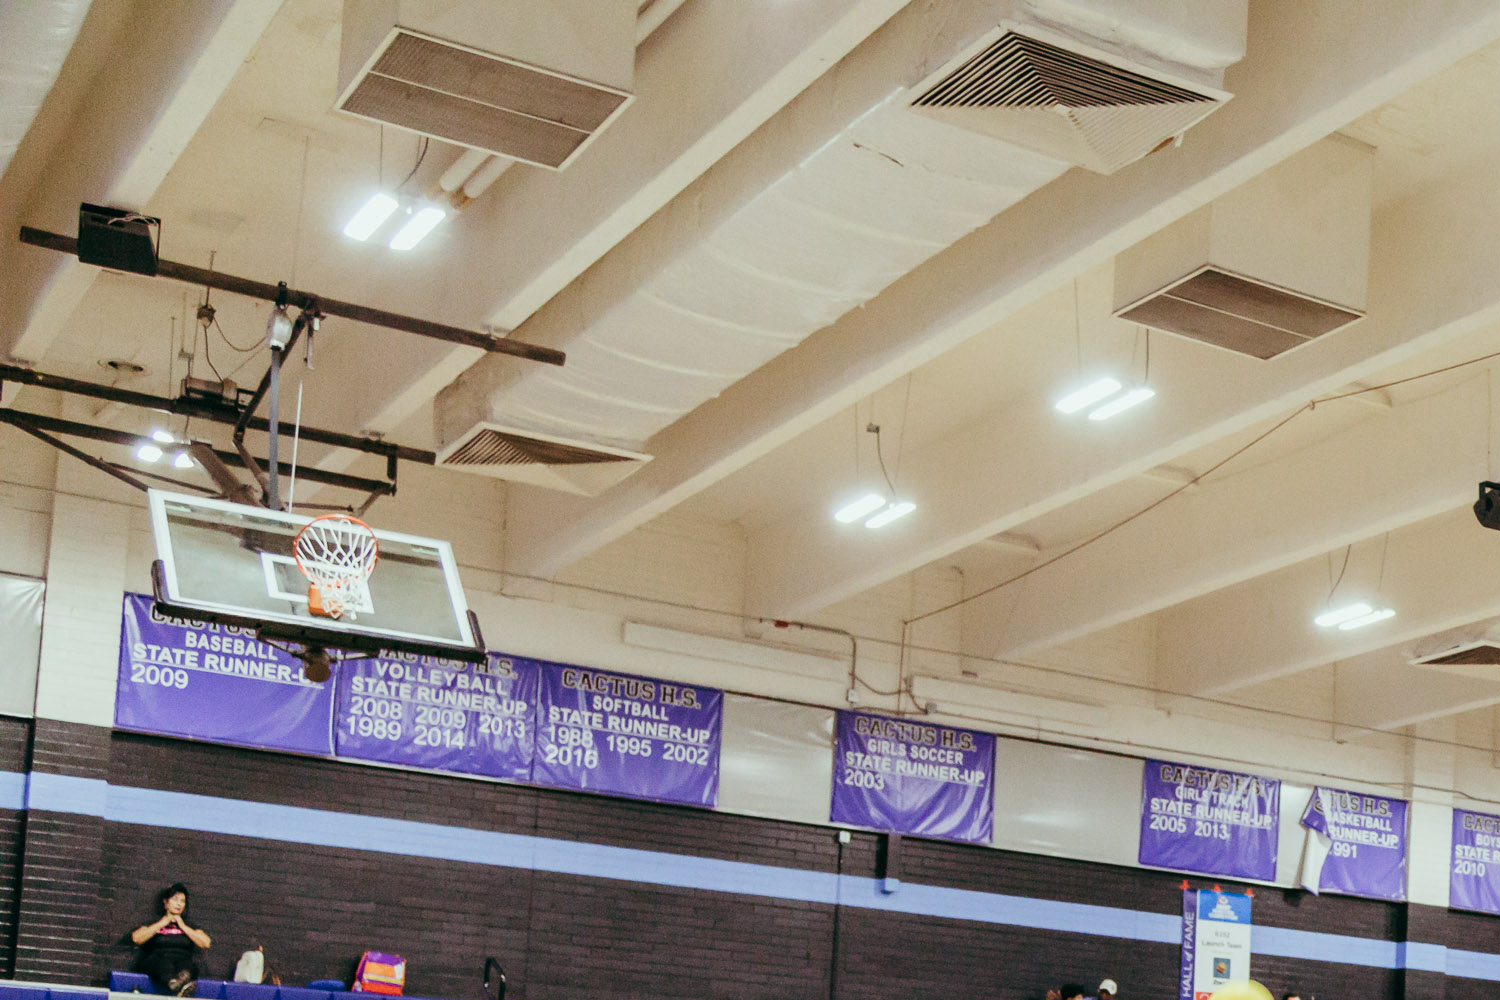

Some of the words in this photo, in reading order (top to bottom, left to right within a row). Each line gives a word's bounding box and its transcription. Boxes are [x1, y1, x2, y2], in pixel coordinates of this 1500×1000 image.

[133, 643, 198, 667] STATE
[186, 632, 278, 661] BASEBALL
[131, 664, 189, 689] 2009
[376, 661, 508, 696] VOLLEYBALL
[562, 669, 655, 701] CACTUS
[660, 686, 701, 710] H.S.
[352, 676, 411, 699] STATE
[418, 687, 527, 715] RUNNER-UP
[593, 696, 669, 721] SOFTBALL
[350, 697, 402, 720] 2008
[415, 706, 466, 729] 2009
[479, 715, 525, 739] 2013
[549, 706, 603, 729] STATE
[608, 716, 710, 745] RUNNER-UP
[347, 716, 402, 741] 1989
[414, 725, 465, 750] 2014
[549, 725, 594, 749] 1988
[607, 735, 652, 757] 1995
[663, 743, 709, 766] 2002
[855, 716, 936, 745] CACTUS
[941, 730, 977, 752] H.S.
[545, 744, 599, 769] 2016
[868, 739, 906, 757] GIRLS
[910, 746, 964, 765] SOCCER
[844, 769, 885, 790] 2003
[846, 752, 891, 771] STATE
[896, 759, 985, 785] RUNNER-UP
[1160, 766, 1231, 790] CACTUS
[1175, 786, 1209, 803] GIRLS
[1212, 791, 1248, 809] TRACK
[1364, 799, 1392, 818] H.S.
[1150, 798, 1192, 815] STATE
[1196, 805, 1272, 827] RUNNER-UP
[1150, 814, 1187, 833] 2005
[1194, 821, 1230, 840] 2013
[1330, 842, 1357, 858] 991
[1455, 844, 1490, 861] STATE
[1454, 859, 1485, 877] 2010
[1184, 912, 1195, 949] FAME
[1182, 963, 1194, 997] HALL
